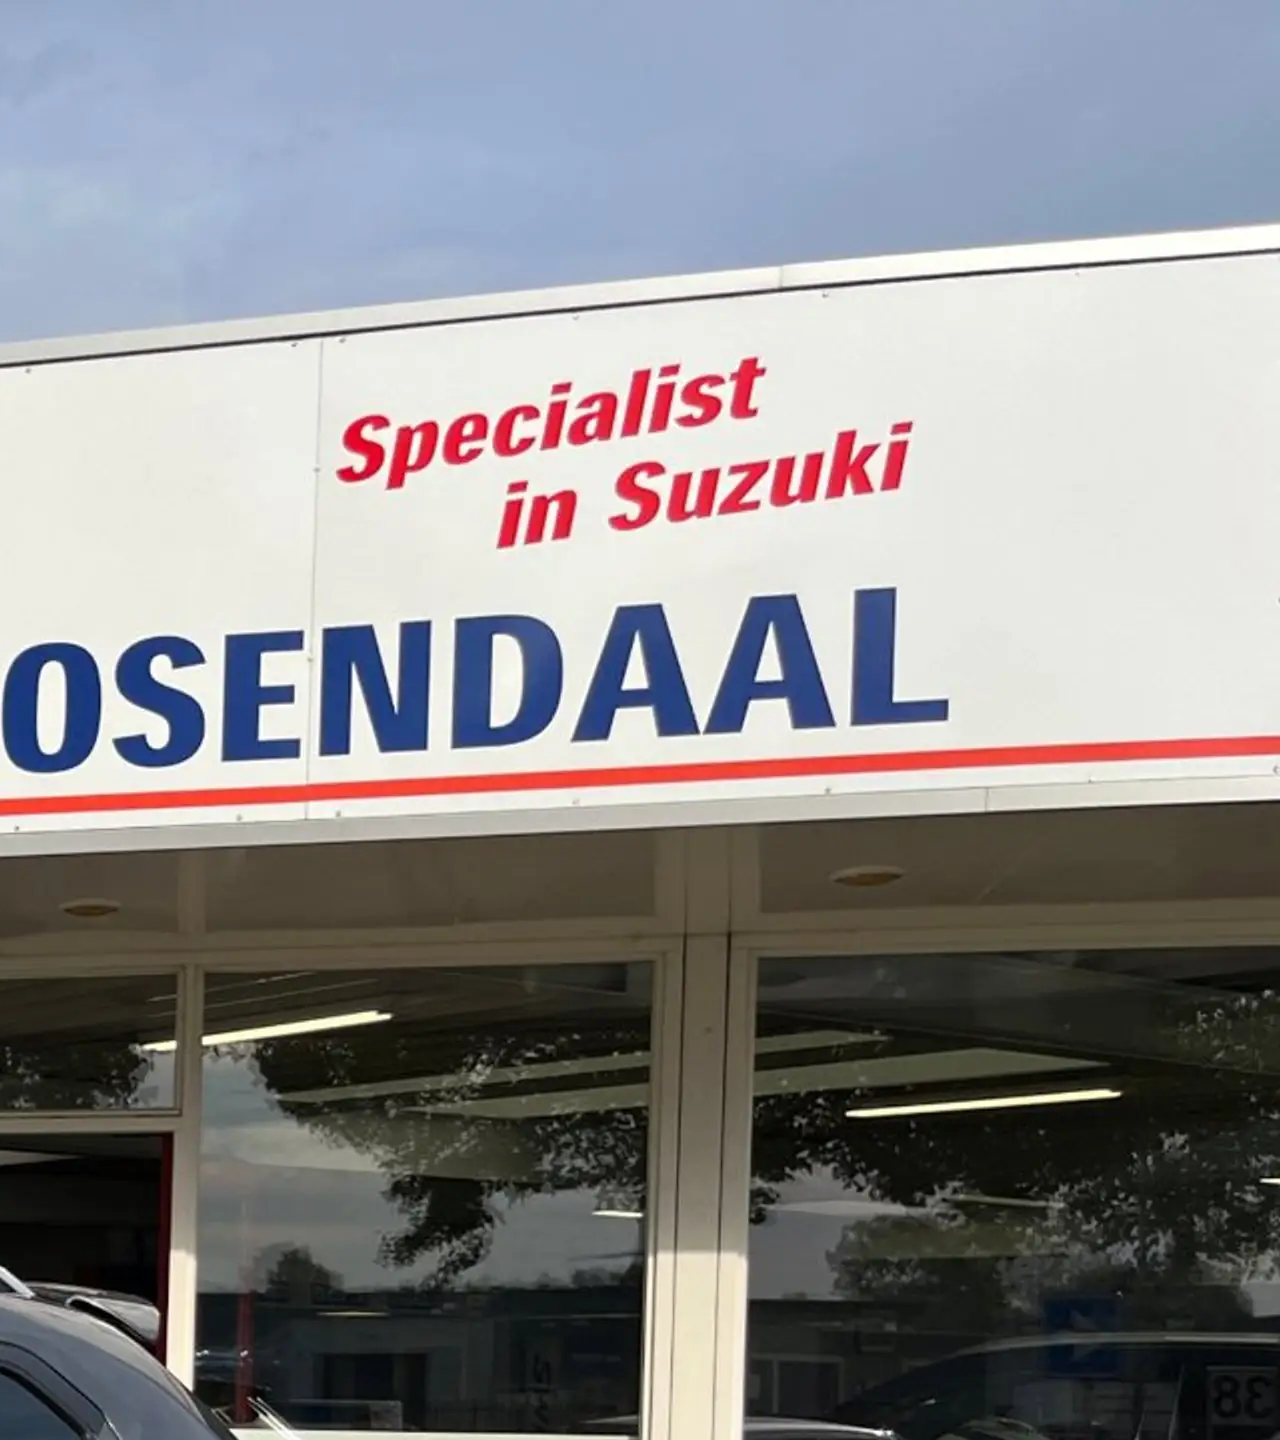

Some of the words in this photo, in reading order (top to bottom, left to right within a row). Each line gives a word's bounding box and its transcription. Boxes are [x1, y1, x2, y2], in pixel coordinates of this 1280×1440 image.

[336, 357, 767, 490] Specialist
[497, 479, 578, 550] in
[608, 421, 914, 531] Suzuki
